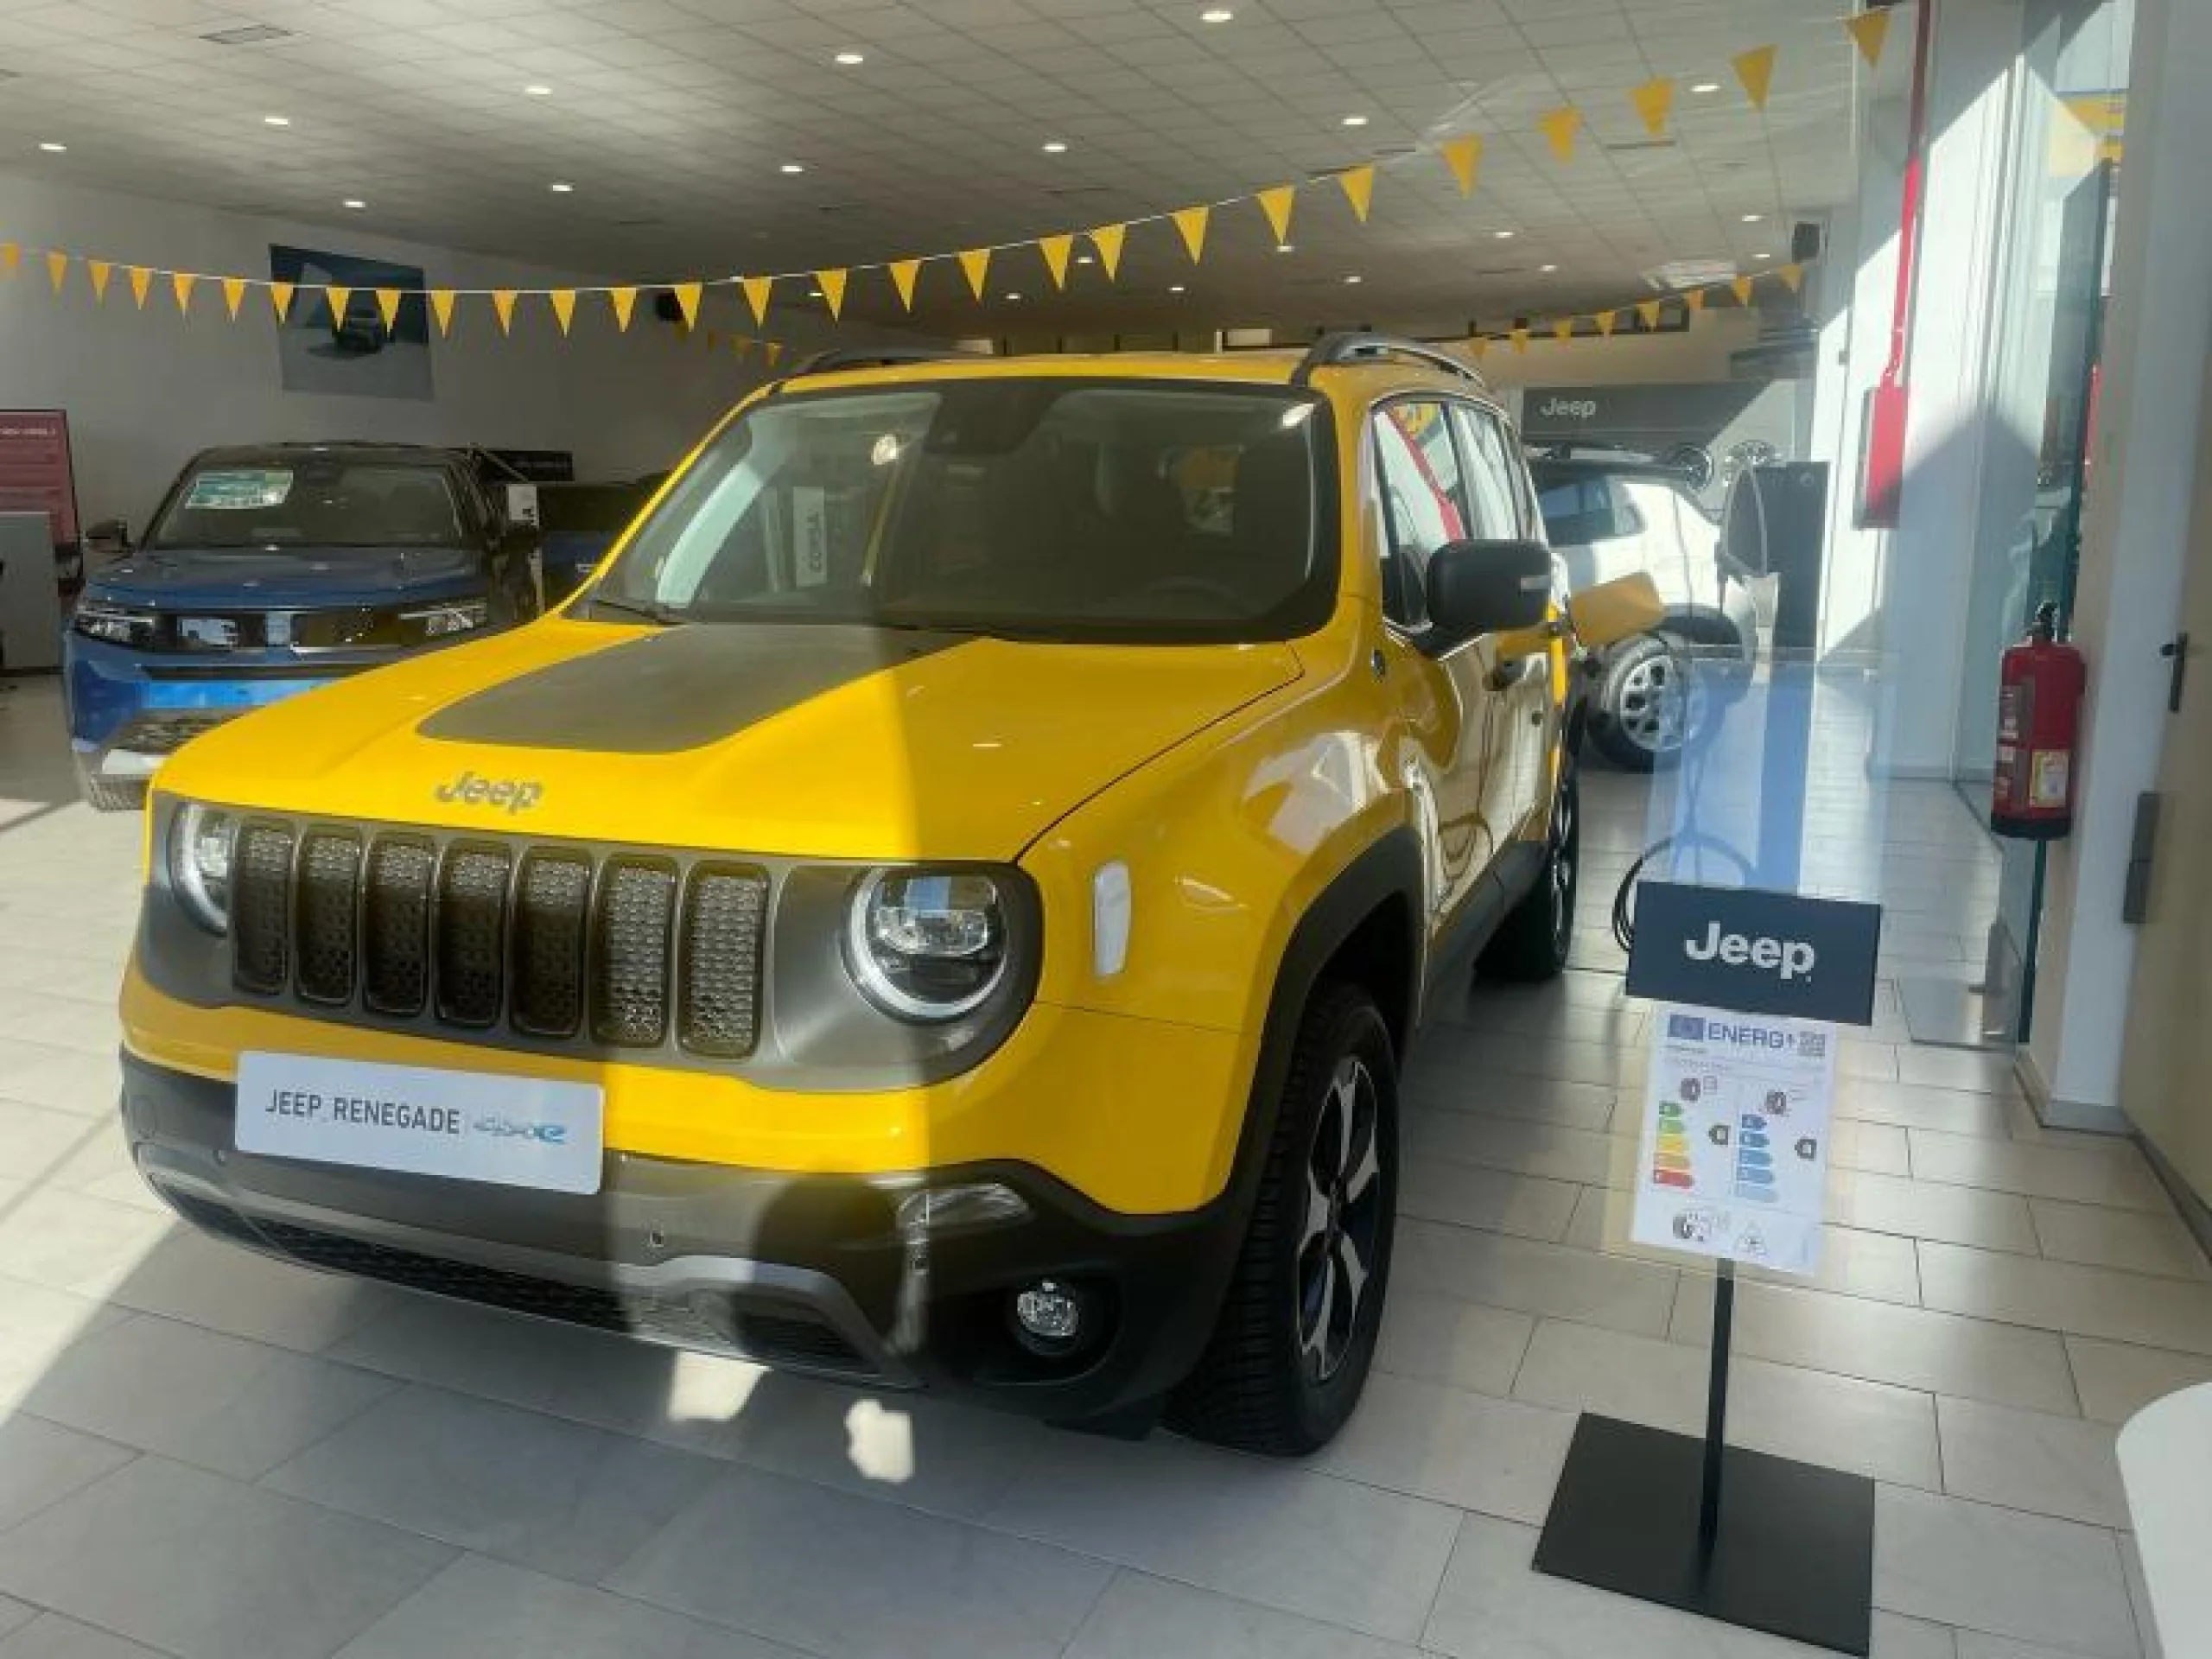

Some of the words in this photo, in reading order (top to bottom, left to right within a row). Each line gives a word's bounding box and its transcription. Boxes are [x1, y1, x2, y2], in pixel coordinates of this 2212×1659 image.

[1539, 397, 1596, 418] Jeep
[435, 770, 542, 816] Jeep
[1685, 920, 1815, 981] Jeep
[264, 1088, 322, 1117] JEEP
[333, 1096, 461, 1135] RENEGADE
